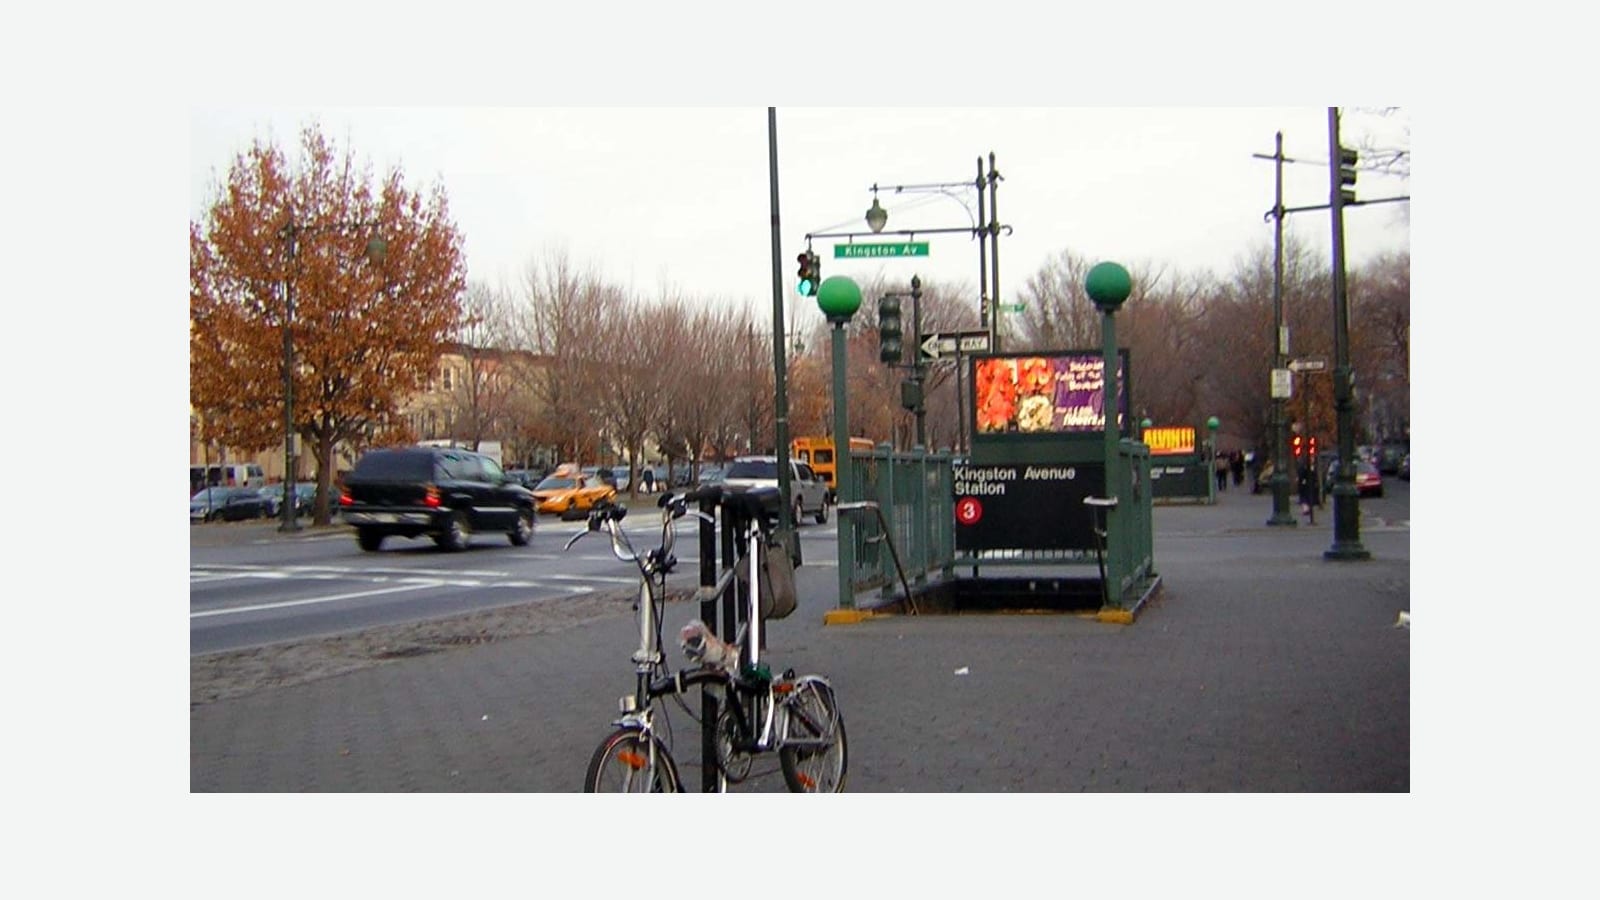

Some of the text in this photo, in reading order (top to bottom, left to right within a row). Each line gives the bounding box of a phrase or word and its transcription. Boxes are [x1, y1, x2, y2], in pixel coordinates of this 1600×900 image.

[845, 244, 918, 257] Kingston Av
[963, 338, 984, 351] WAY
[954, 466, 1076, 481] Kingston Avenue
[955, 481, 1006, 496] Station
[962, 501, 976, 519] 3
